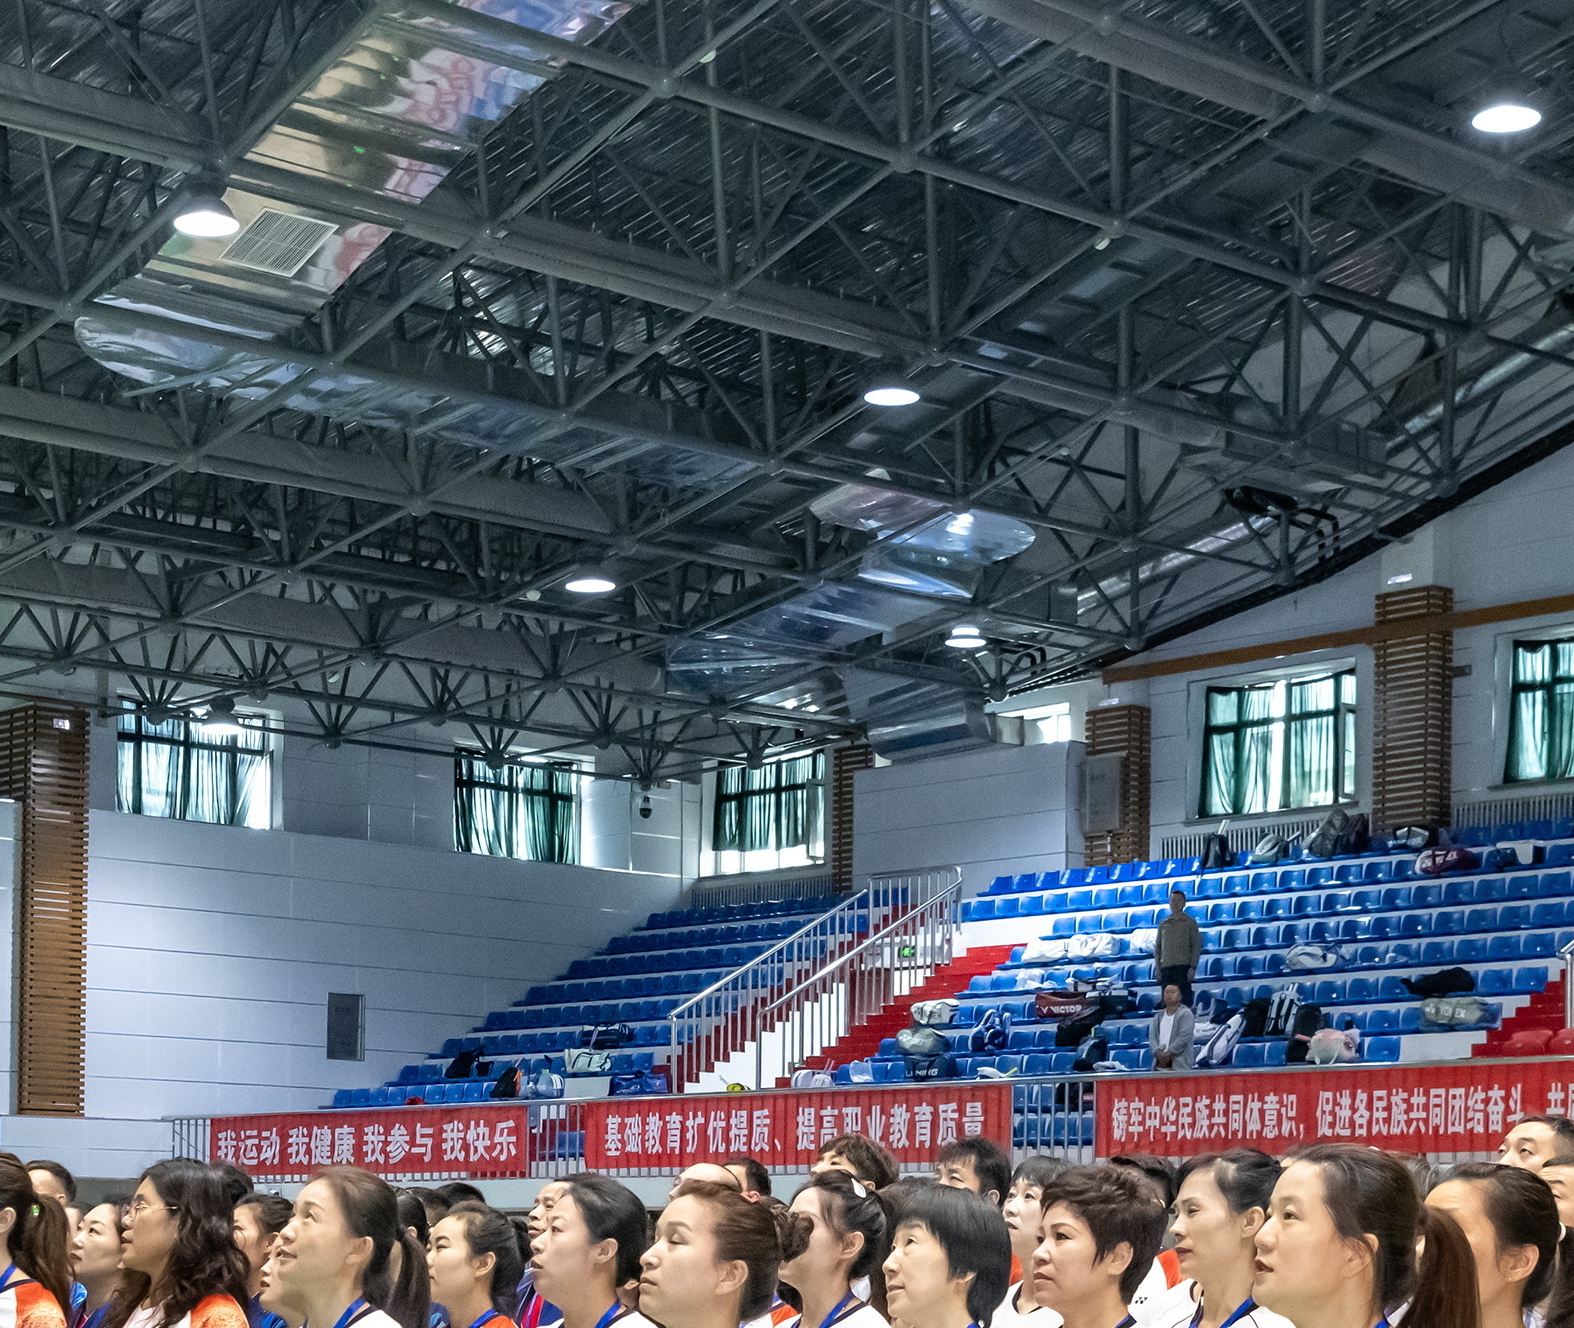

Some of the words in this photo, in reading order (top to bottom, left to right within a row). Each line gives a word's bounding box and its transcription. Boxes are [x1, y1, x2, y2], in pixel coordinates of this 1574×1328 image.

[217, 1127, 280, 1167] 我运动
[287, 1124, 356, 1166] 我健康
[363, 1122, 433, 1165] 我参与
[441, 1119, 517, 1162] 我快乐
